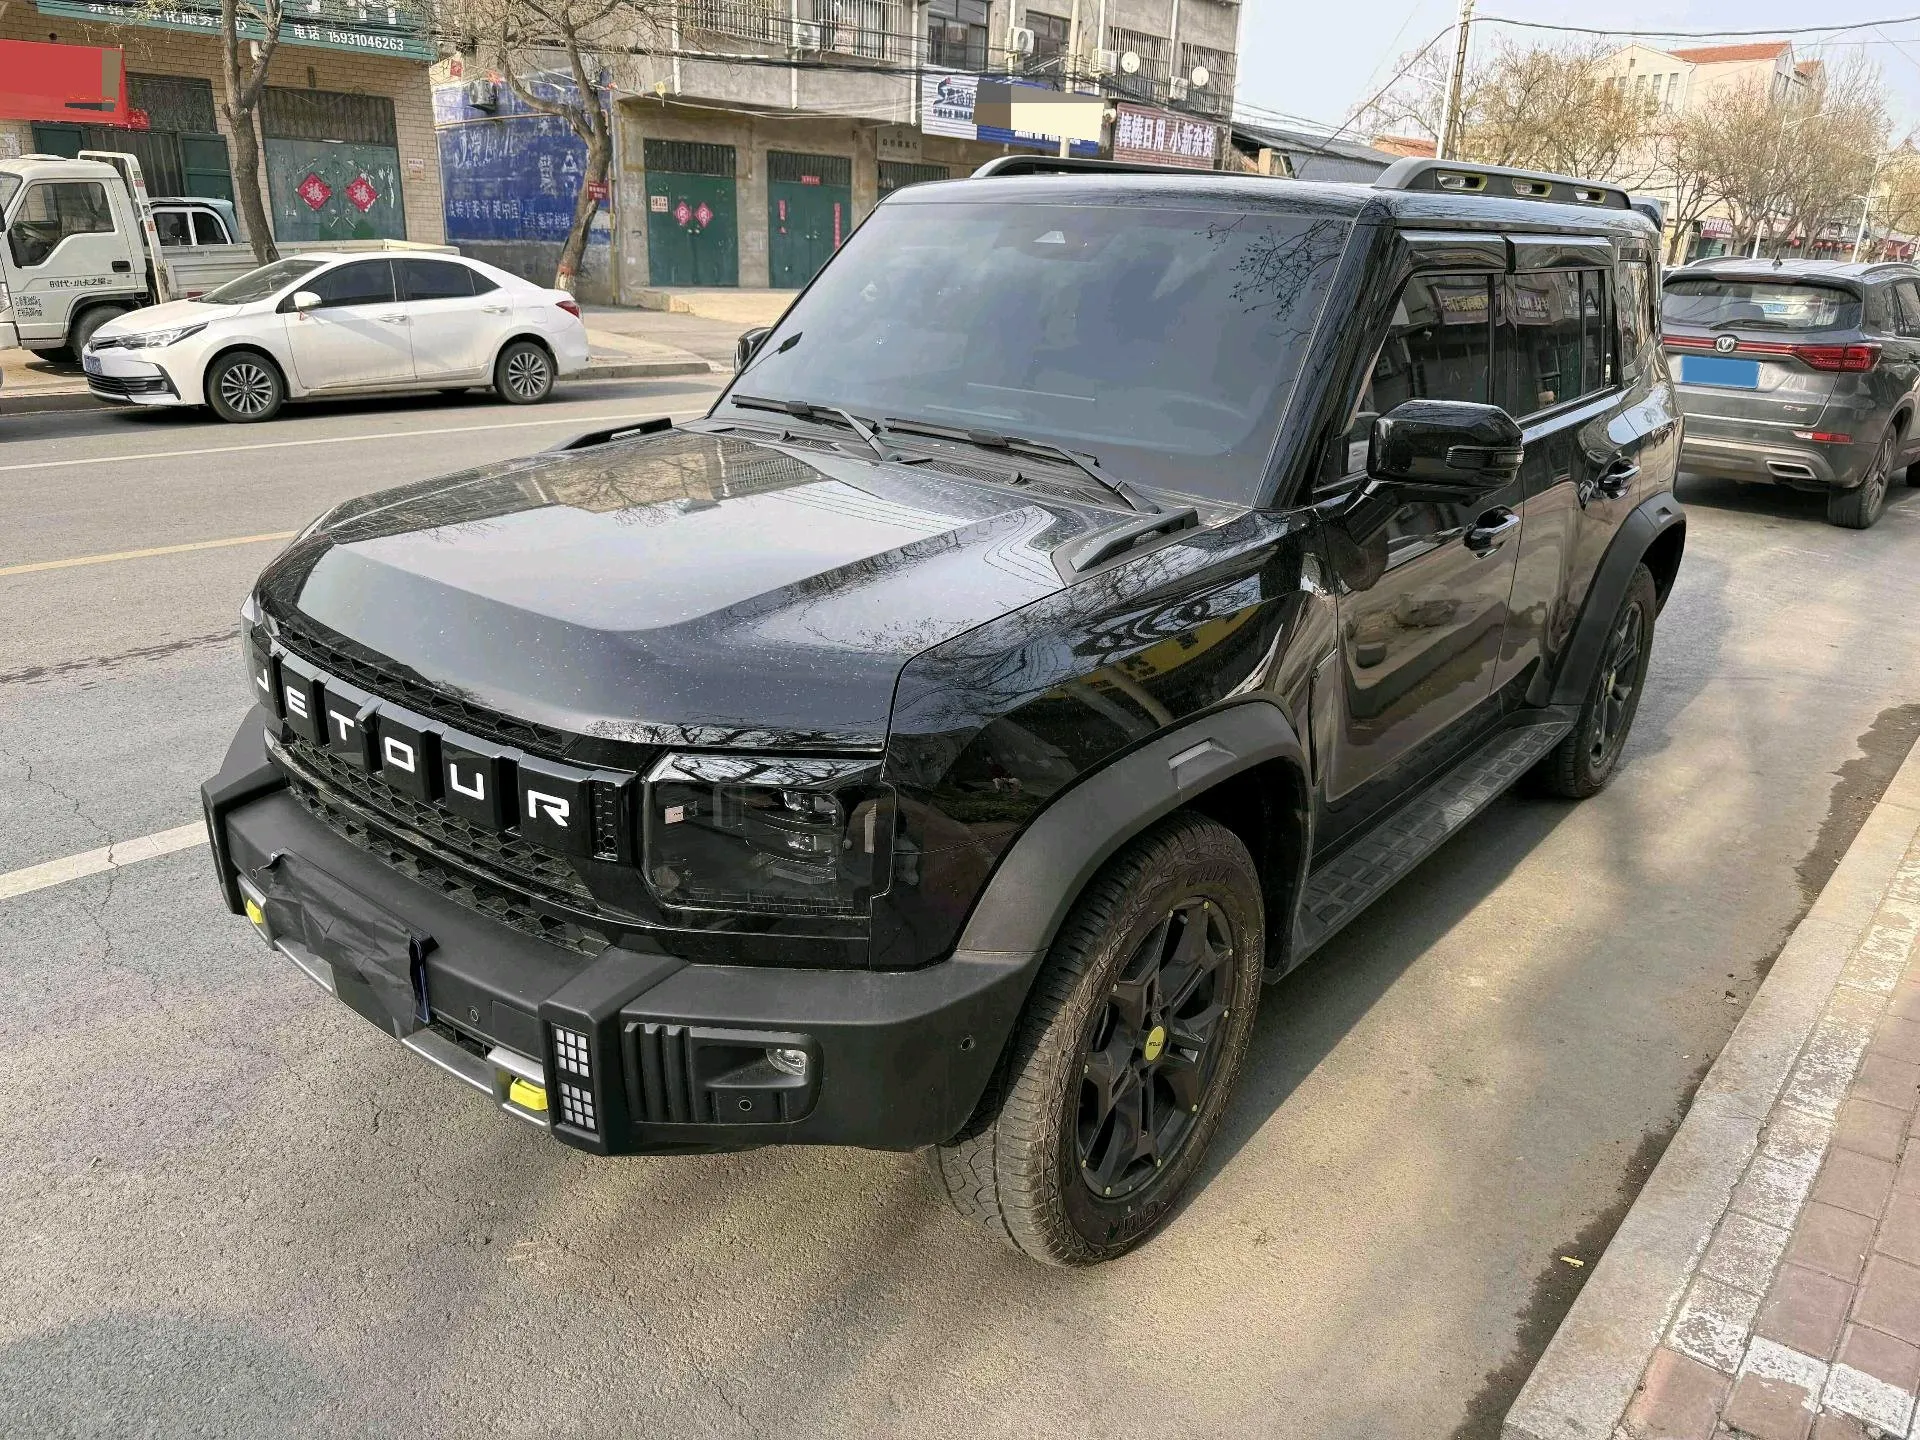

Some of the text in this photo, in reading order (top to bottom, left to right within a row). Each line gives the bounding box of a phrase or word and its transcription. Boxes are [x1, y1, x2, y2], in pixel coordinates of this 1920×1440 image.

[294, 24, 404, 51] 电话 15931046263
[256, 667, 570, 827] JETOUR
